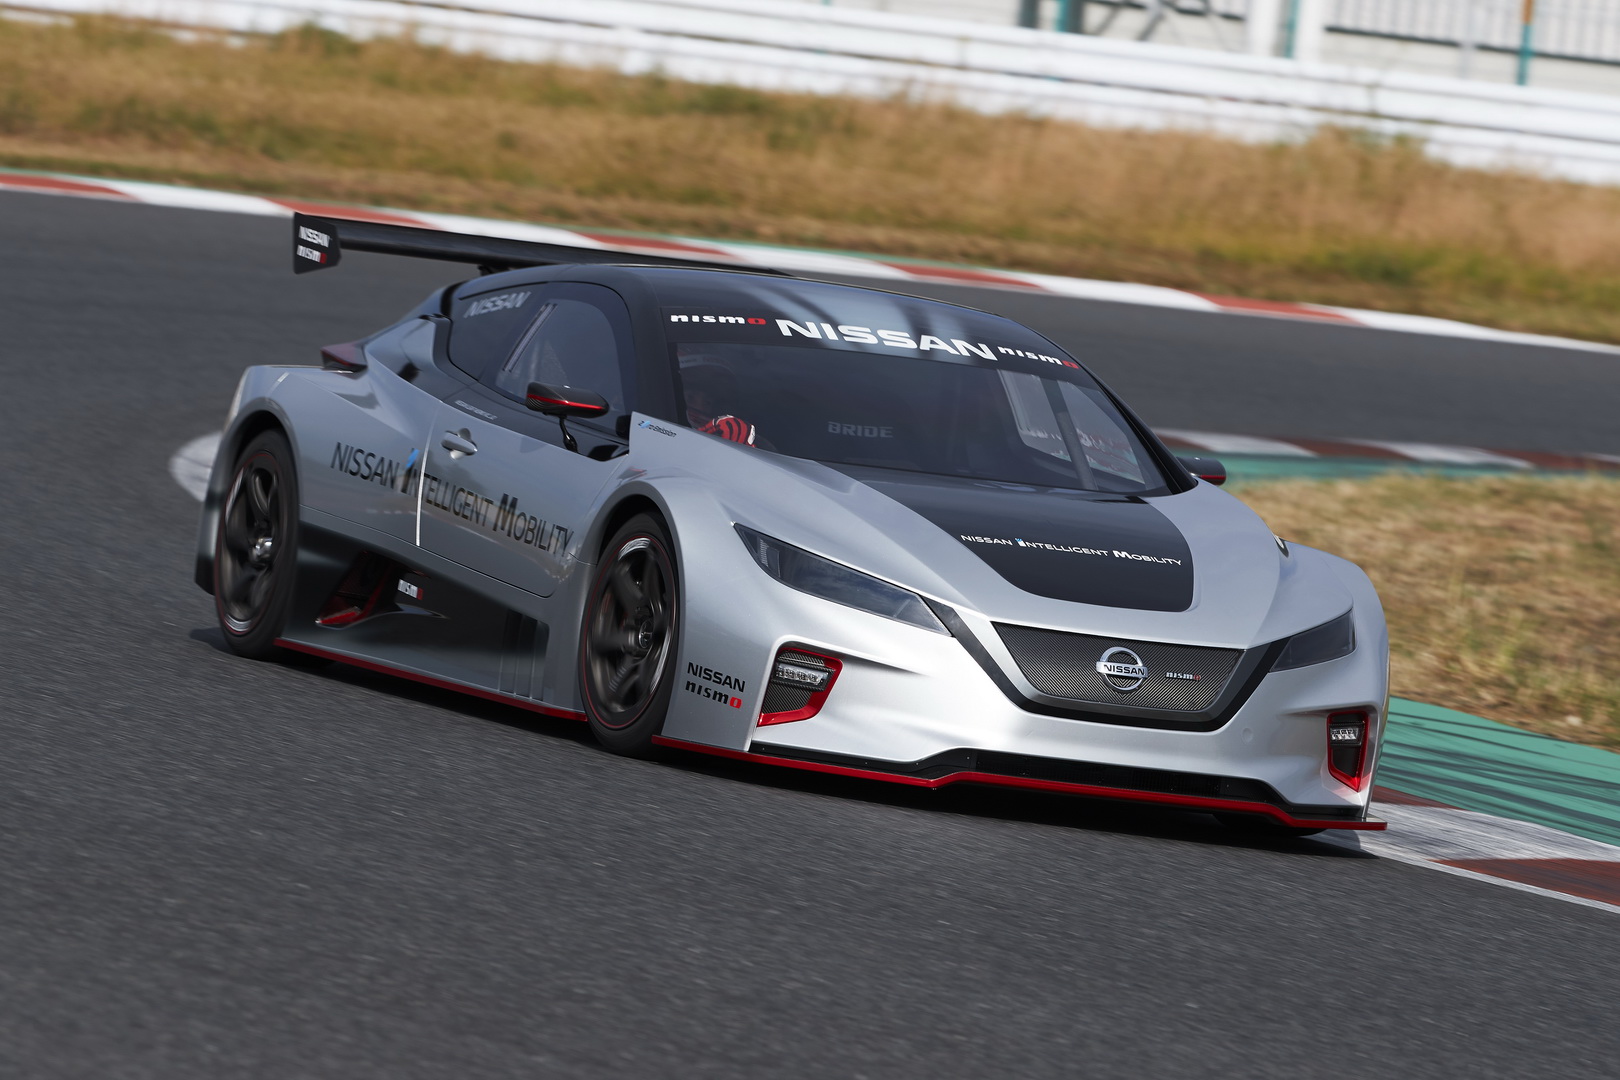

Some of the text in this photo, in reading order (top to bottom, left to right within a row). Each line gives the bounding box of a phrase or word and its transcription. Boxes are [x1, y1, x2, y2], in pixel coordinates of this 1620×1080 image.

[298, 225, 331, 248] NISSAN
[296, 244, 327, 264] nismo
[463, 291, 532, 319] NISSAN
[670, 314, 1079, 369] nismo NISSAN nismo
[828, 421, 894, 438] BRIDE
[330, 441, 575, 558] NISSAN INTELLIGENT MOBILITY
[960, 534, 1183, 566] NISSAN INTELLIGENT MOBILITY
[397, 578, 424, 601] nismo
[687, 661, 746, 693] NISSAN
[1103, 663, 1146, 676] NISSAN
[1165, 671, 1202, 681] nismo
[685, 680, 743, 709] nismo
